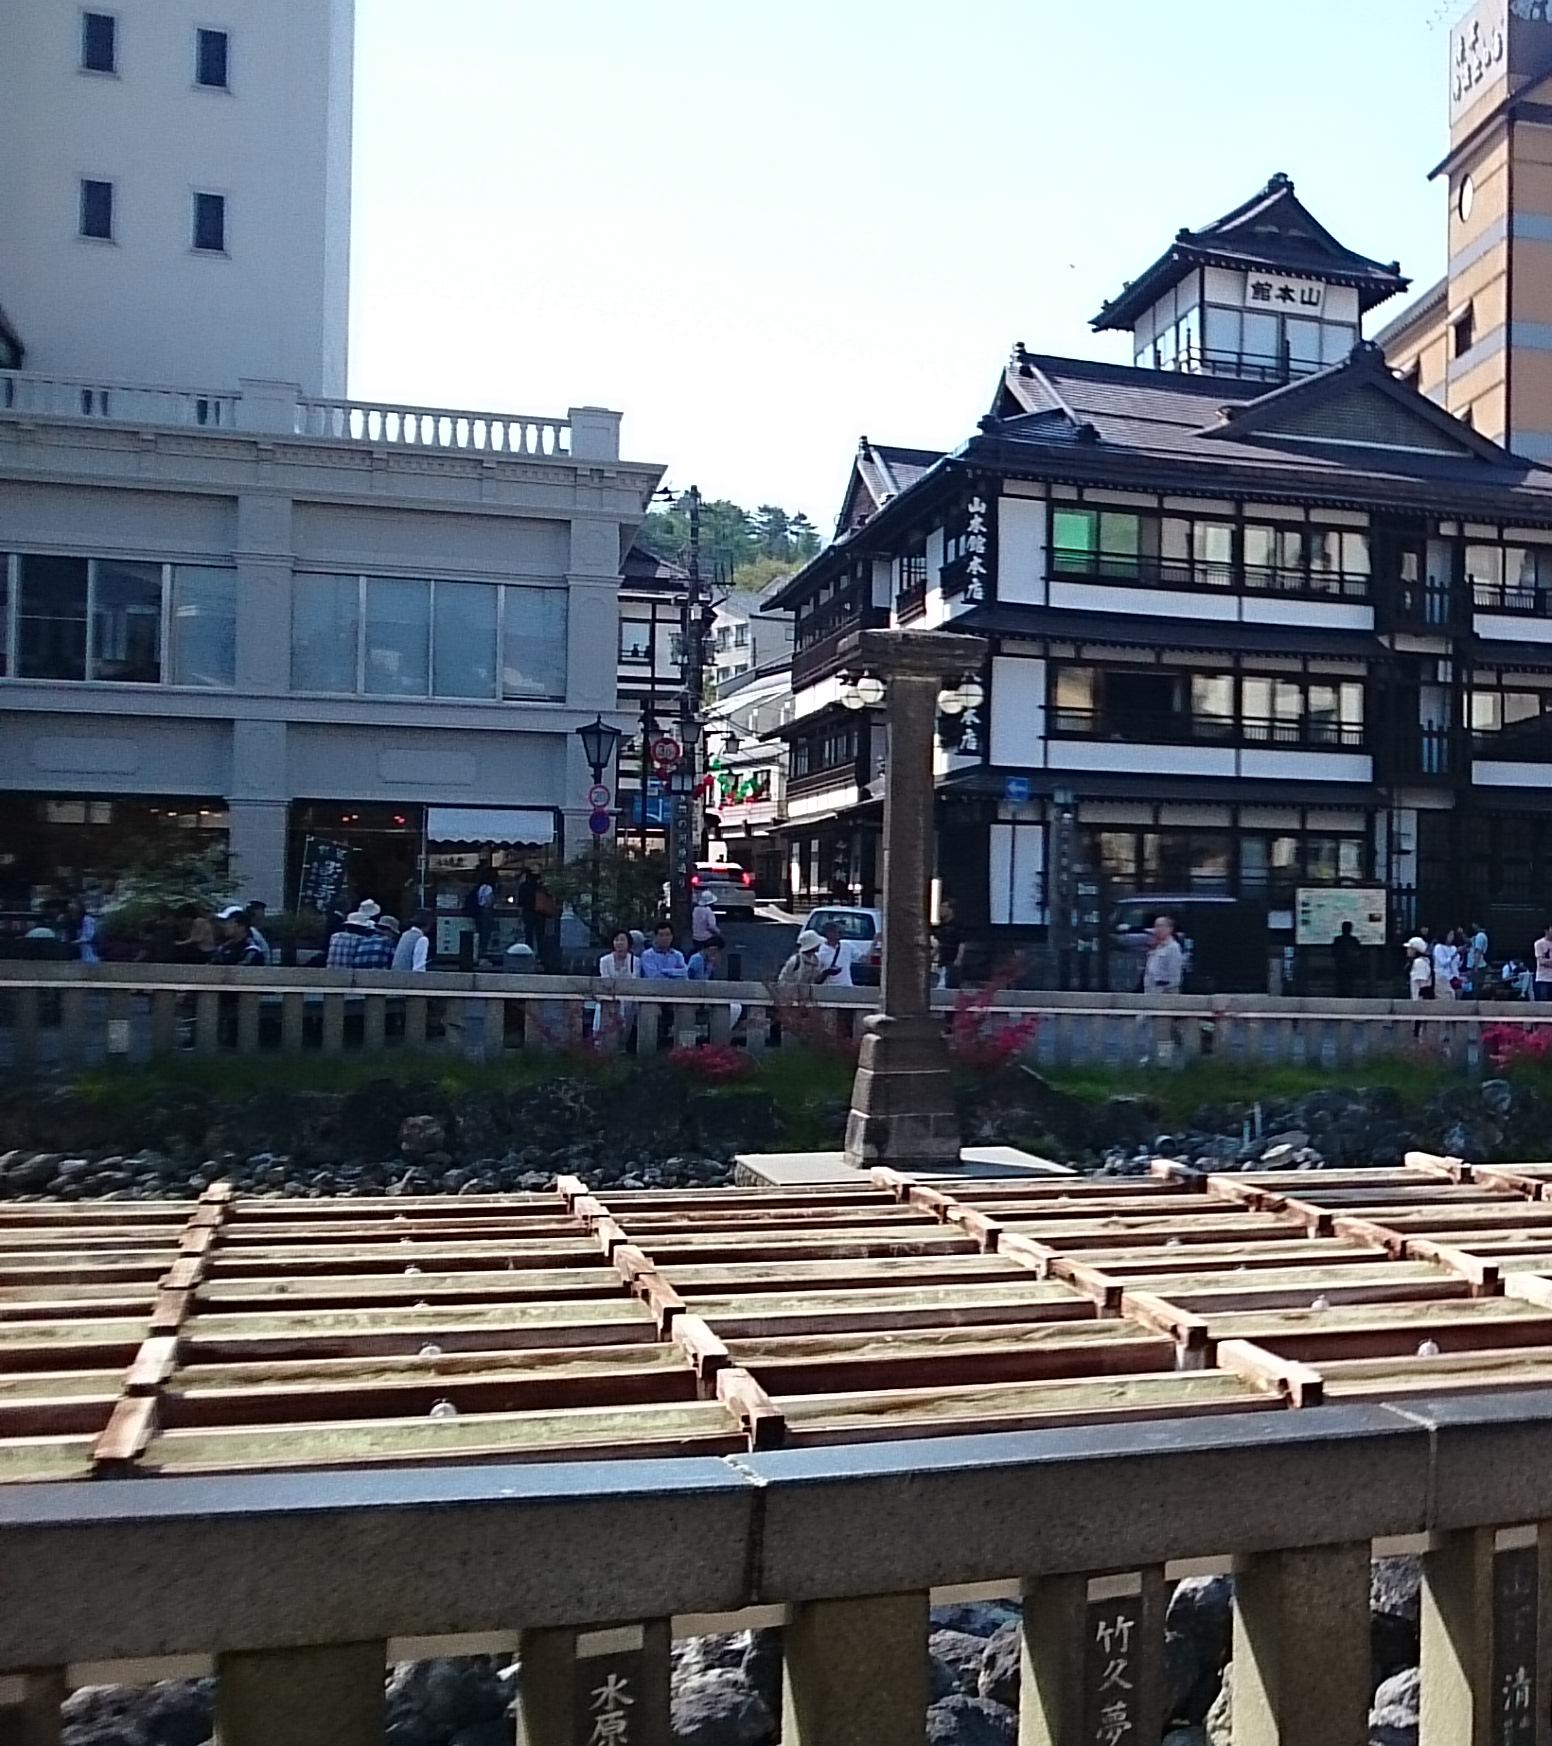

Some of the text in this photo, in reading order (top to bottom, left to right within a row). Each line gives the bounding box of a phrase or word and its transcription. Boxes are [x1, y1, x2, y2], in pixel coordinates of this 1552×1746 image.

[966, 497, 987, 600] 山本館本店
[589, 1674, 635, 1746] 水原
[1096, 1616, 1136, 1746] 竹久夢
